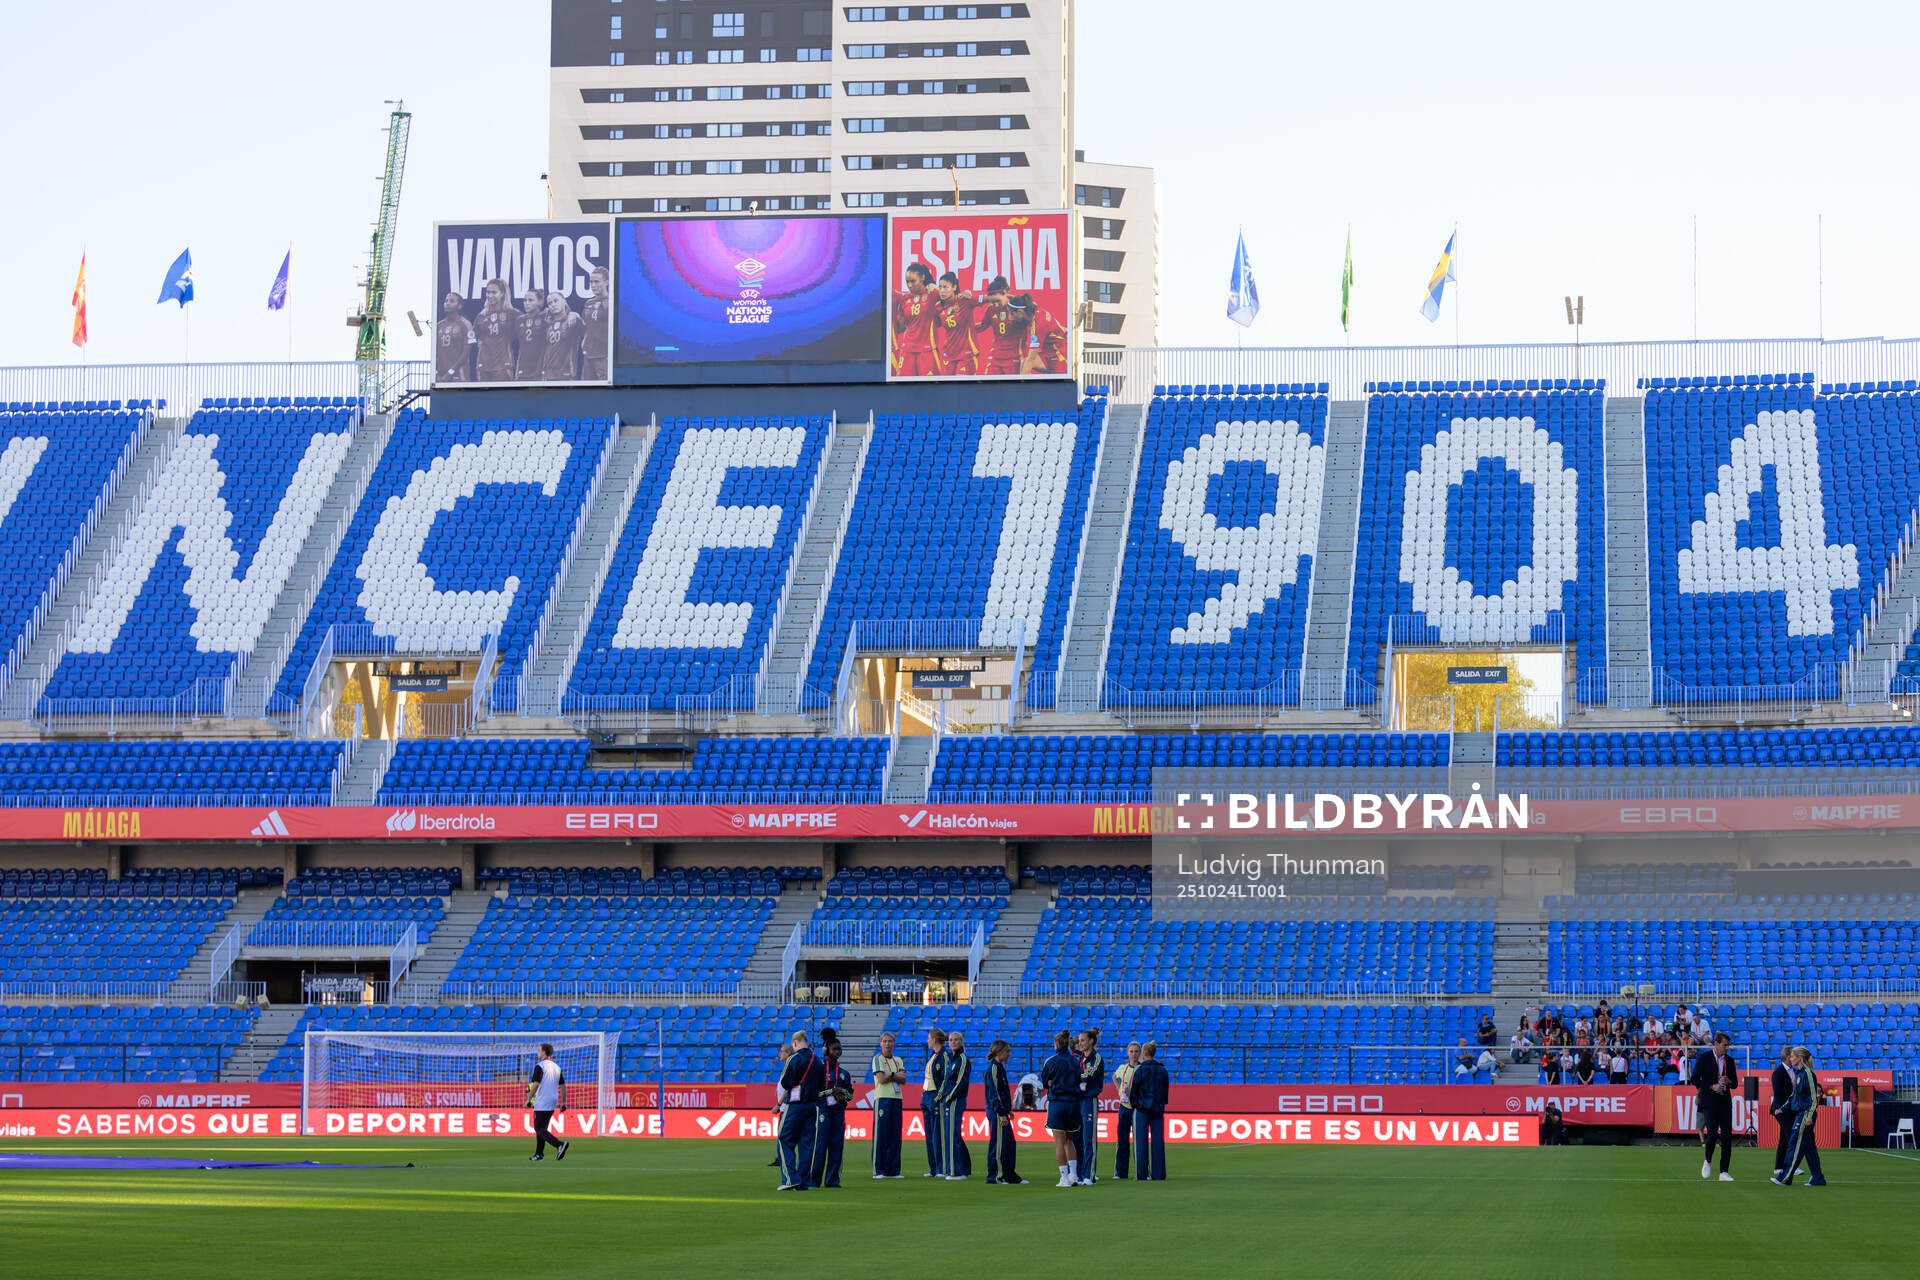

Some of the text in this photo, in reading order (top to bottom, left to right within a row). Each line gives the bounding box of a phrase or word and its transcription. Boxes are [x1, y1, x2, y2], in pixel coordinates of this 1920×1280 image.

[901, 217, 1061, 292] ESPAÑA
[447, 235, 600, 300] VAMOS
[726, 306, 772, 315] NATIONS
[729, 315, 770, 324] LEAGUE
[1455, 670, 1501, 678] SALIDA EXIT
[748, 812, 837, 829] MAPFRE
[929, 812, 1018, 829] Halcón viajes
[1092, 803, 1175, 834] MÁLAGA
[1620, 807, 1716, 823] EBRO
[1811, 804, 1900, 820] MAPFRE
[63, 809, 141, 838] MÁLAGA
[419, 813, 496, 831] Iberdrola
[566, 813, 658, 829] EBRO
[1278, 1095, 1383, 1112] EBRO
[56, 1113, 196, 1134] SABEMOS
[207, 1113, 269, 1134] QUE
[326, 1112, 464, 1133] DEPORTE
[476, 1113, 512, 1134] ES
[576, 1114, 663, 1135] VIAJE
[1168, 1118, 1520, 1142] DEPORTE ES UN VIAJE
